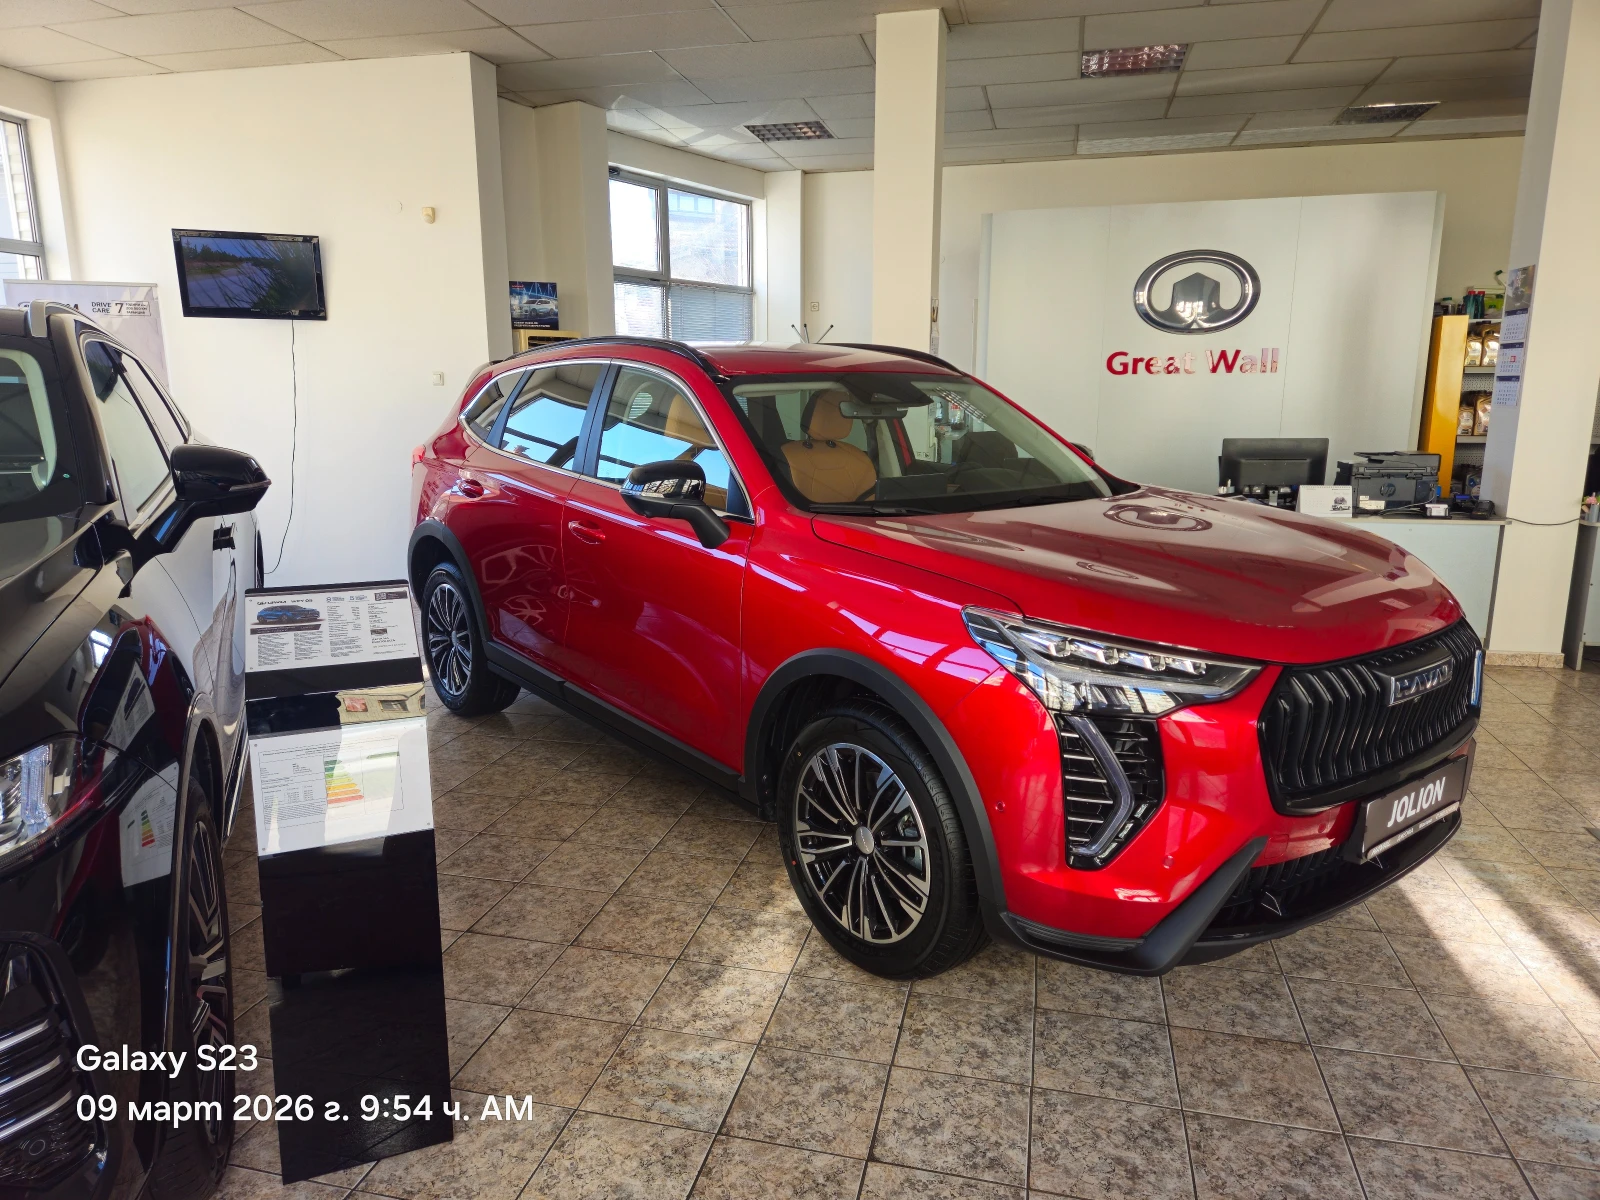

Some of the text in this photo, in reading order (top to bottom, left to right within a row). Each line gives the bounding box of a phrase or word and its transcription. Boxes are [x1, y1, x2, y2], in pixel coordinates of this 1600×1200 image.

[115, 303, 124, 313] 7
[1105, 347, 1280, 376] Great Wall
[1386, 776, 1446, 828] JOLION
